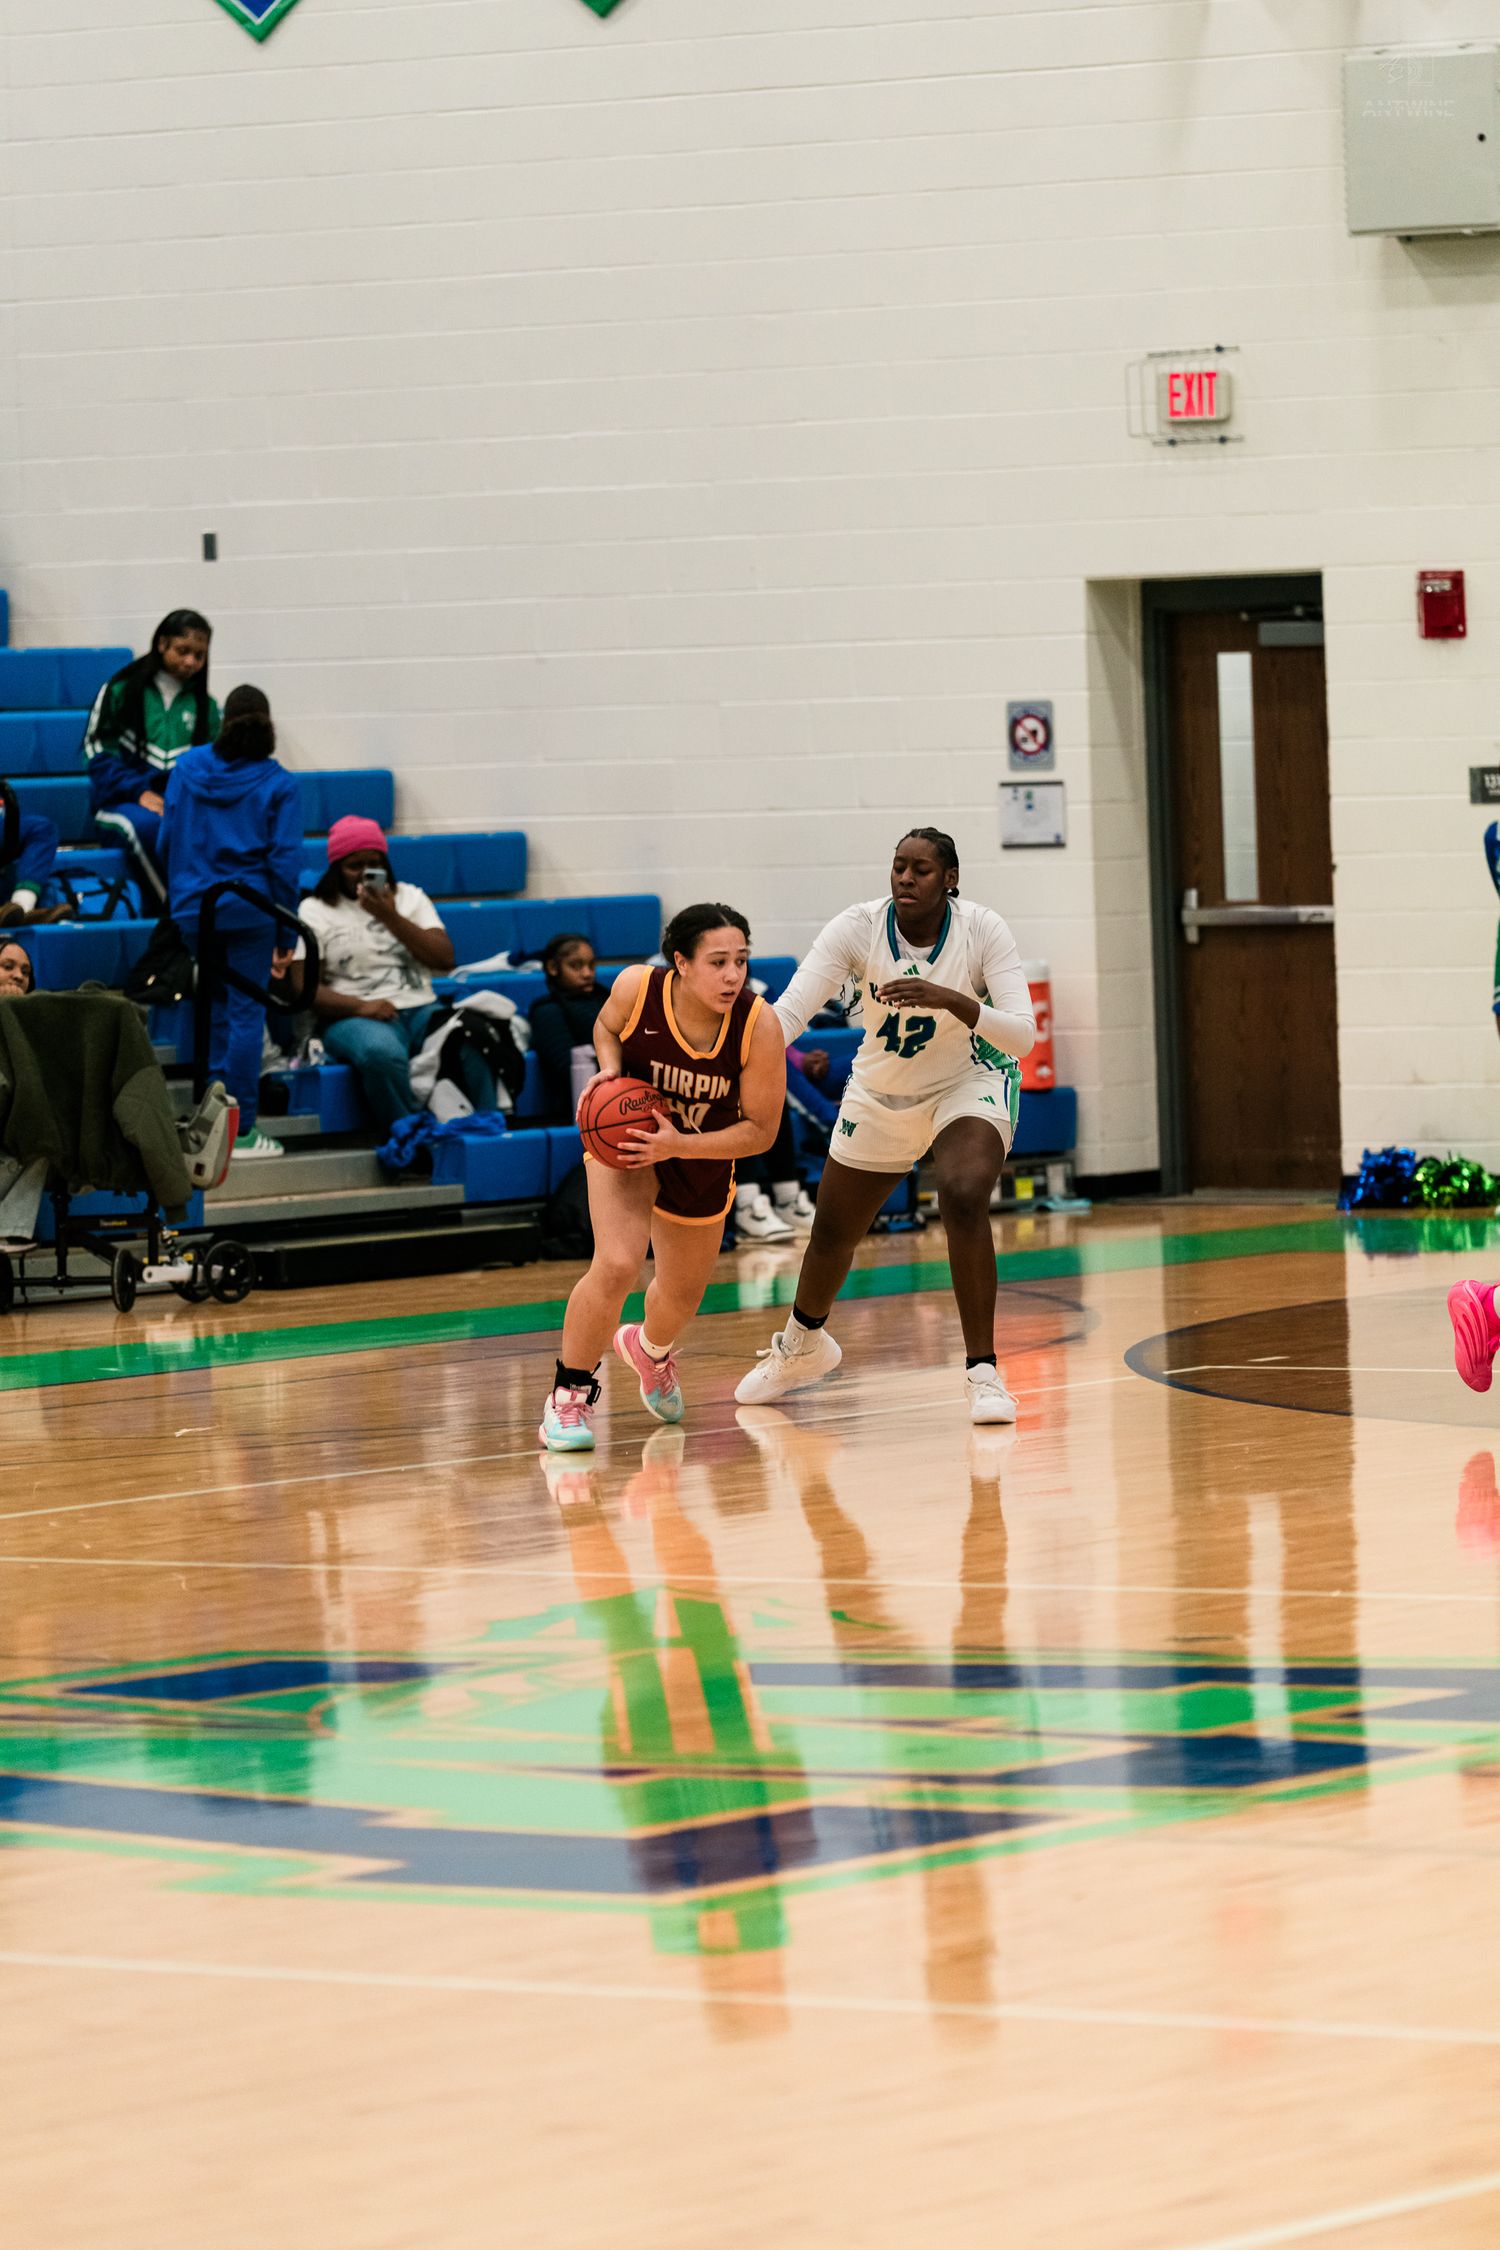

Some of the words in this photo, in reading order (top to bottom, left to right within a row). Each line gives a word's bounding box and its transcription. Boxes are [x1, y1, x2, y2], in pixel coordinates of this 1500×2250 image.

[1168, 372, 1217, 418] EXIT
[876, 1012, 937, 1059] 42
[650, 1060, 731, 1100] TURPIN
[620, 1090, 664, 1116] Rawling
